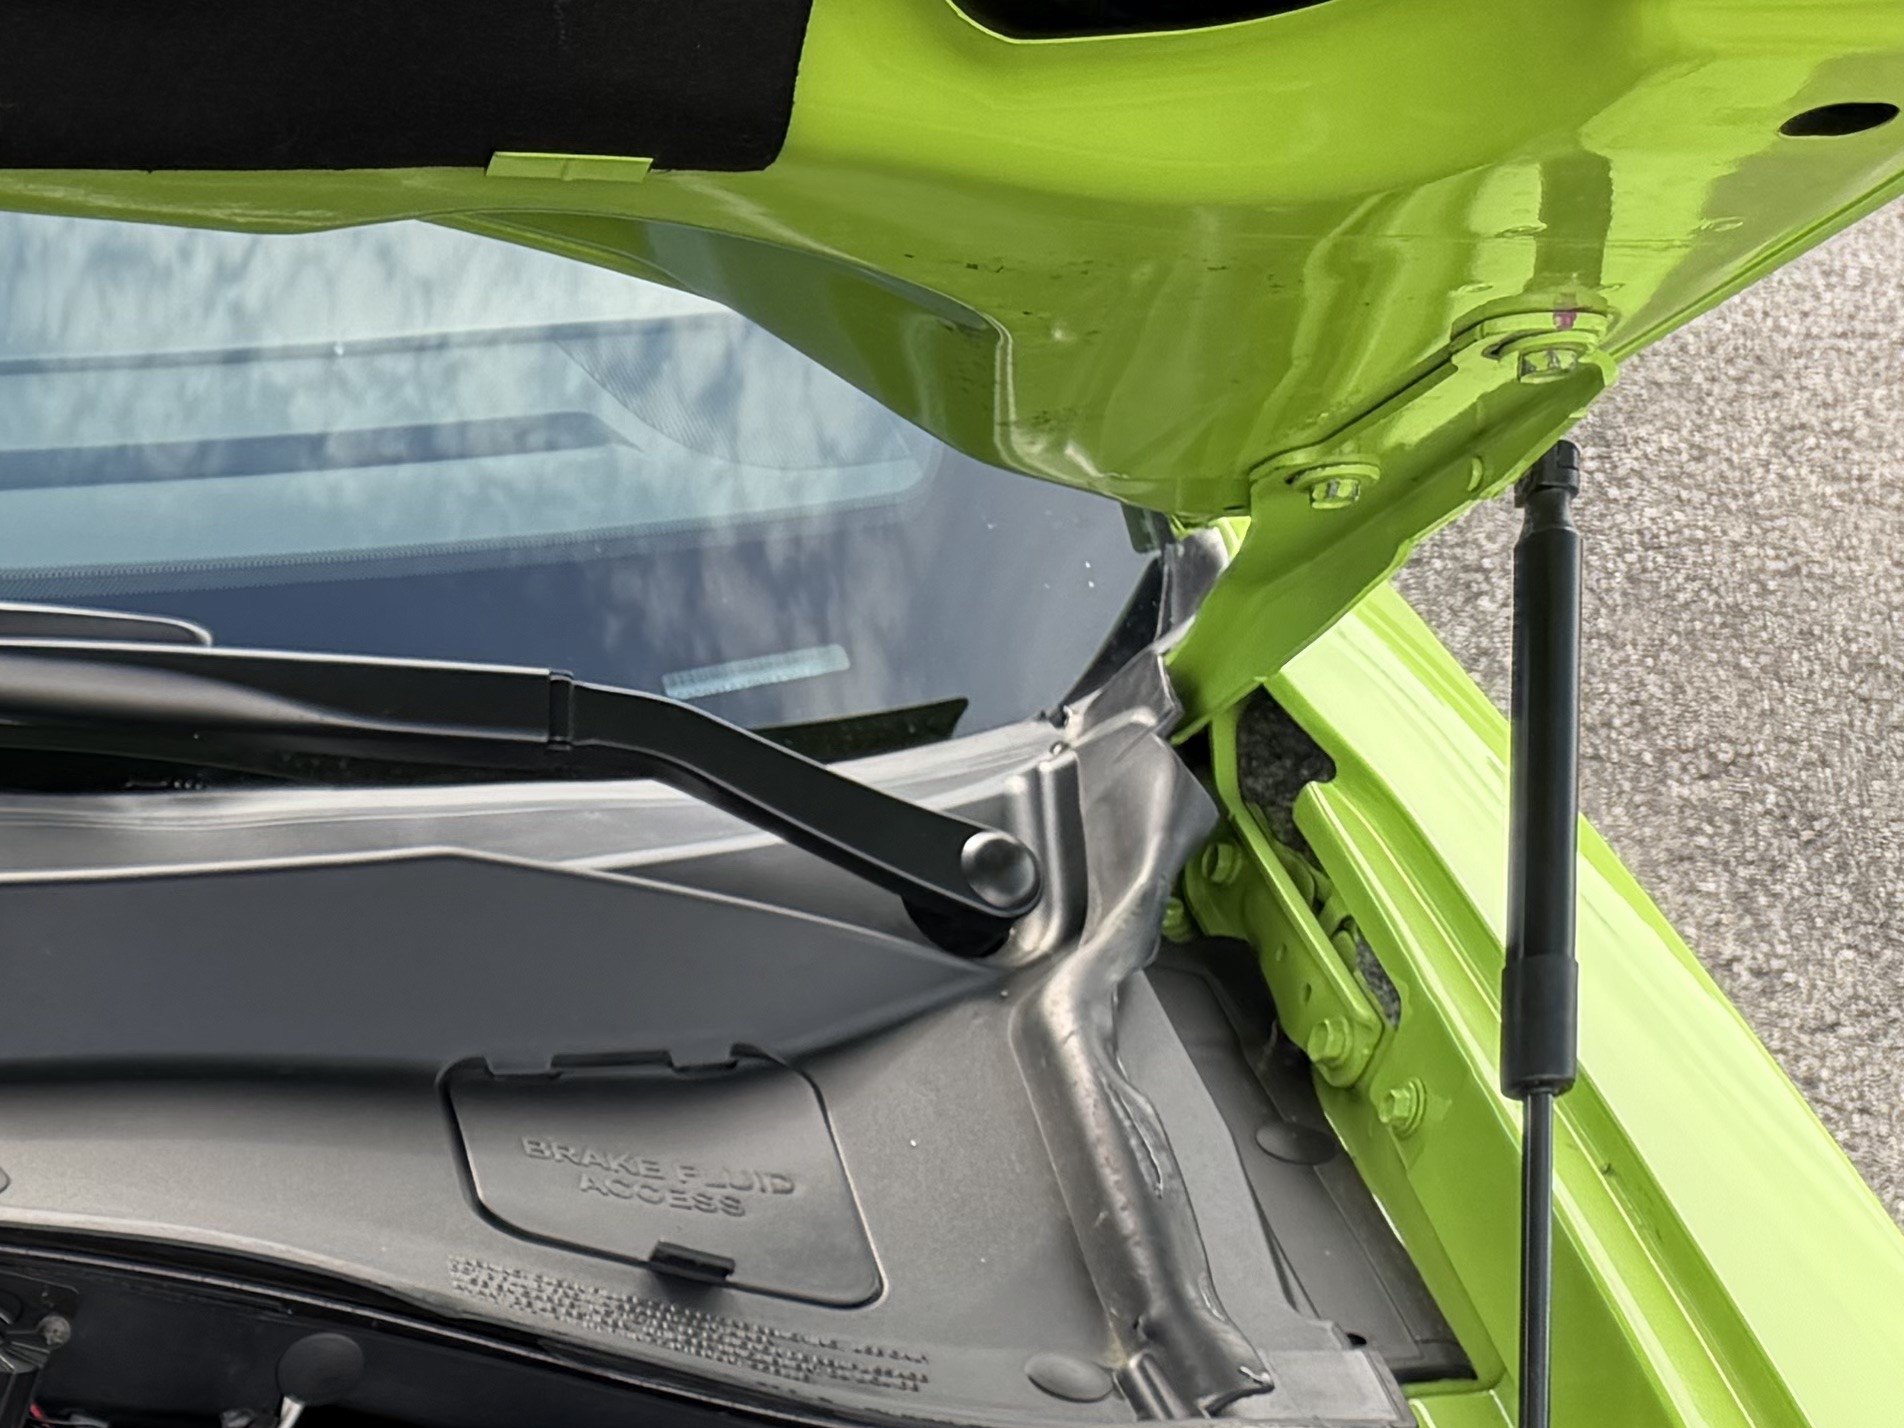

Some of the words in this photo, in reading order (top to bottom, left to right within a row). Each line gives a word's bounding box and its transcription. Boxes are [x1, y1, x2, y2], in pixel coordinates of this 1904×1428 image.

[521, 1136, 666, 1180] BRAKE
[678, 1164, 797, 1196] FLUID
[579, 1172, 747, 1217] ACCESS
